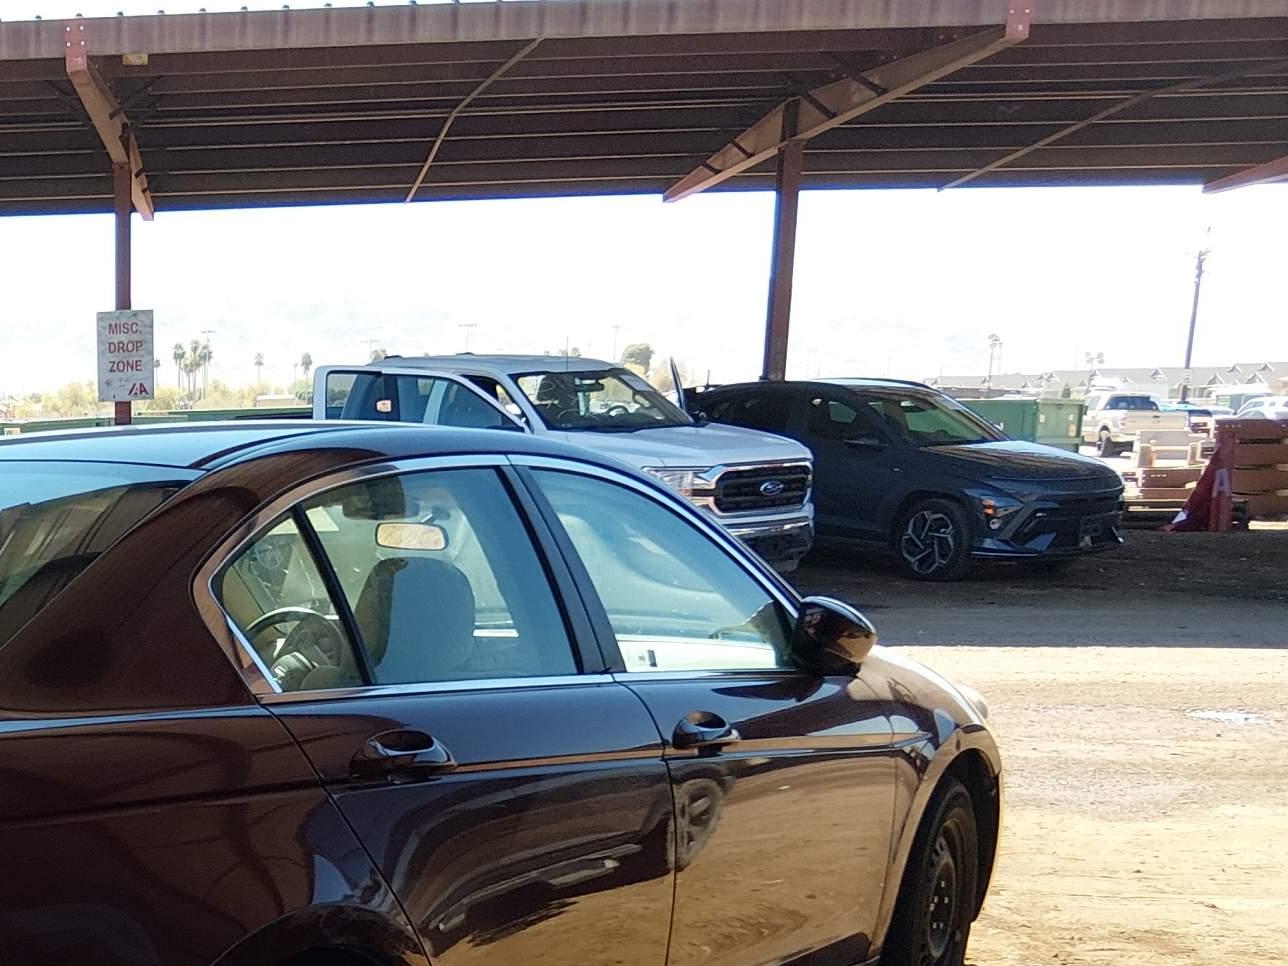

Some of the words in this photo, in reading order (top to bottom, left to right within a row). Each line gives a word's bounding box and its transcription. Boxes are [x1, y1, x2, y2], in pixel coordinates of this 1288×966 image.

[108, 321, 142, 335] MISC.
[108, 340, 144, 354] DROP
[108, 359, 143, 373] ZONE
